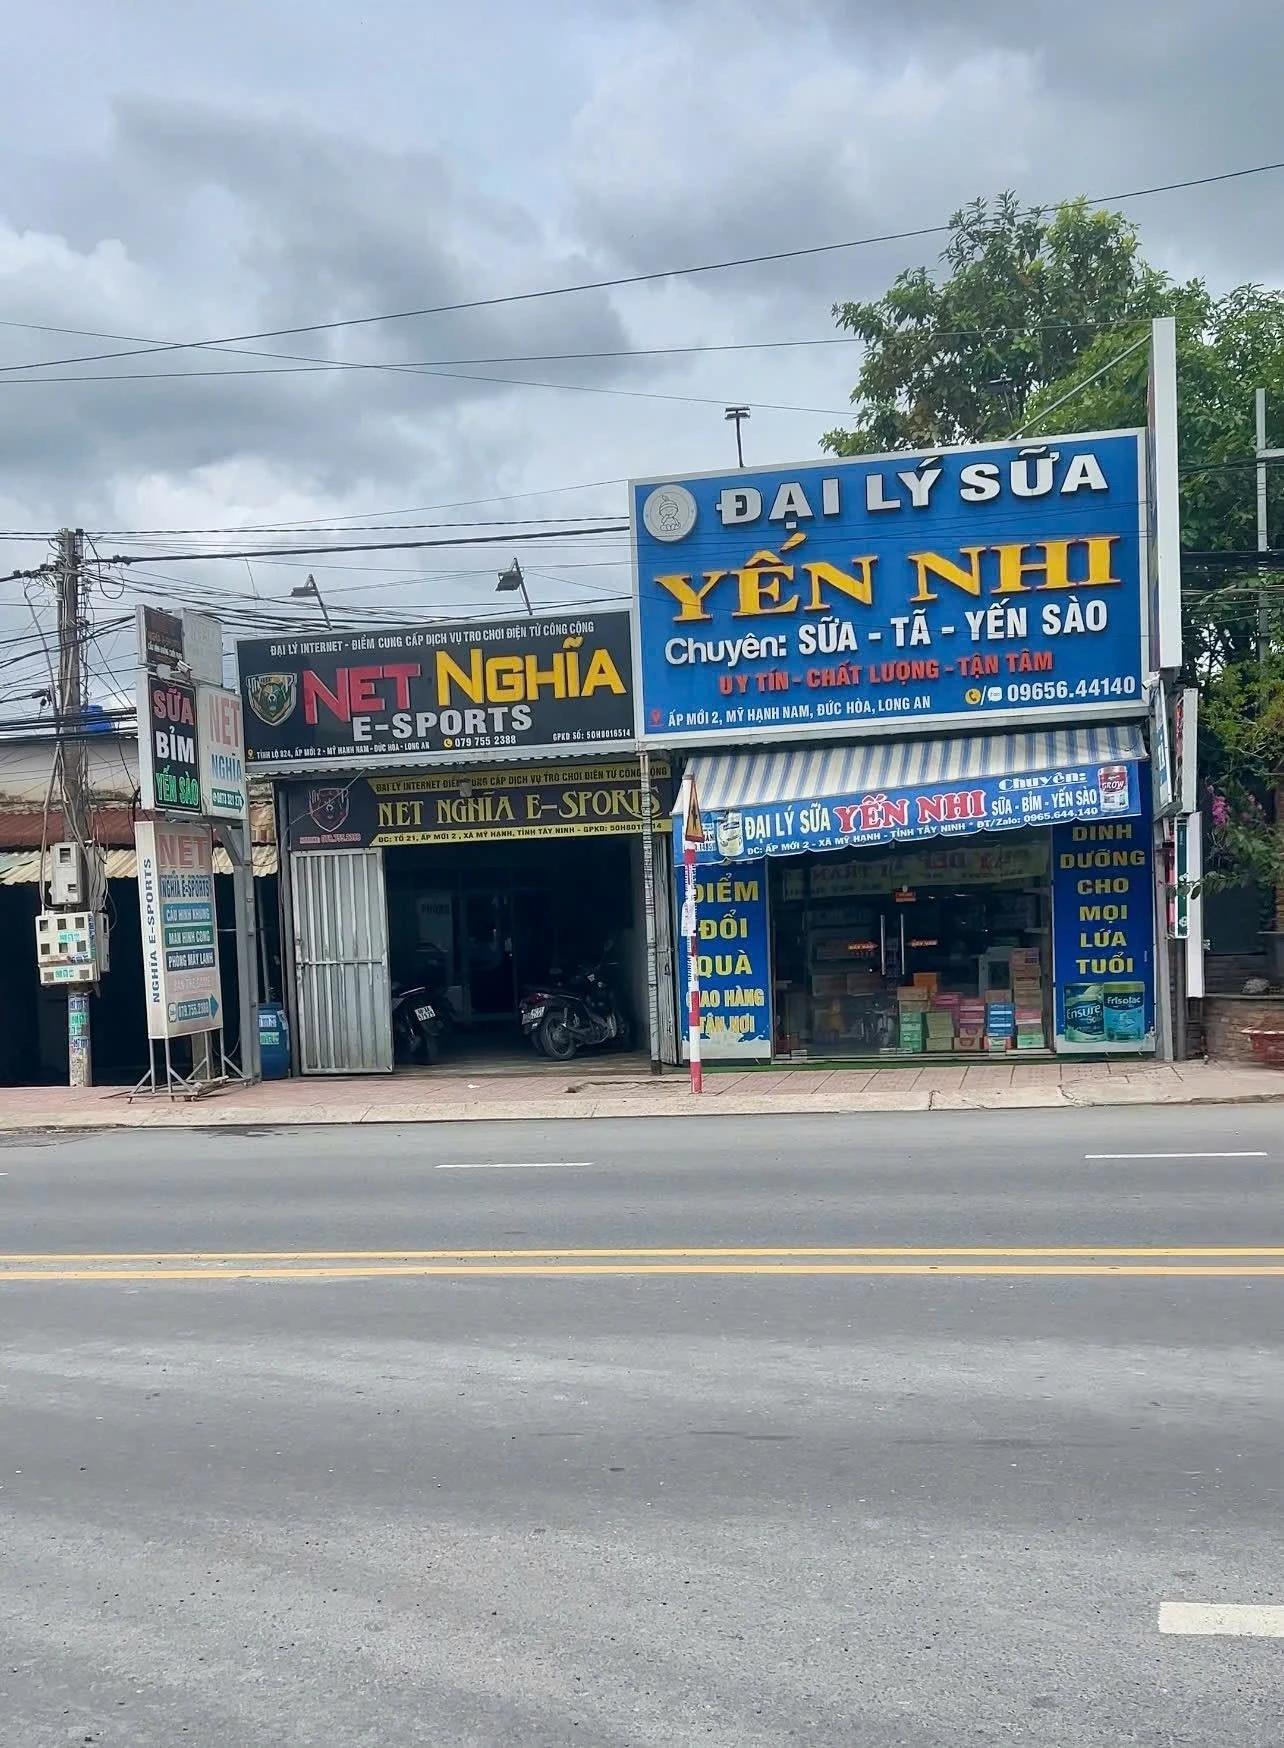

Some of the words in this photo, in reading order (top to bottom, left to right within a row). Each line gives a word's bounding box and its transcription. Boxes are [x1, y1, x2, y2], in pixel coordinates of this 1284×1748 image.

[715, 481, 840, 530] ĐẠI
[865, 456, 943, 513] LÝ
[959, 446, 1109, 502] SỮA
[654, 532, 880, 623] YẾN
[907, 535, 1121, 604] NHI
[288, 641, 298, 655] LÝ
[300, 640, 343, 655] INTERNET
[351, 634, 375, 651] ĐIỂM
[378, 636, 403, 649] CUNG
[405, 629, 424, 647] CẤP
[426, 632, 447, 647] DỊCH
[450, 631, 463, 645] VỤ
[506, 624, 527, 640] ĐIỆN
[529, 622, 542, 637] TỬ
[543, 621, 568, 637] CÔNG
[569, 620, 595, 636] CỘNG
[664, 632, 788, 667] Chuyên:
[798, 616, 859, 656] SỮA
[890, 607, 932, 648] TÃ
[964, 597, 1028, 641] YẾN
[1041, 595, 1108, 636] SÀO
[303, 663, 421, 725] NET
[435, 636, 627, 707] NGHĨA
[718, 674, 749, 696] UY
[756, 667, 789, 693] TÍN
[806, 658, 863, 689] CHẤT
[868, 659, 940, 686] LƯỢNG
[958, 653, 999, 680] TẬN
[1005, 648, 1054, 673] TÂM
[1007, 675, 1136, 702] 09656.44140
[153, 688, 195, 726] SỮA
[208, 694, 240, 748] NET
[352, 704, 533, 742] E-SPORTS
[667, 708, 684, 727] ẤP
[712, 710, 723, 726] 2,
[725, 704, 744, 722] MỸ
[747, 705, 781, 723] HẠNH
[783, 703, 814, 720] NAM,
[816, 697, 843, 715] ĐỨC
[847, 700, 875, 714] HÒA,
[878, 697, 910, 713] LONG
[913, 695, 931, 710] AN
[155, 726, 195, 765] BỈM
[454, 738, 473, 748] 079
[474, 737, 491, 747] 755
[493, 734, 517, 746] 2388
[178, 771, 199, 806] SÀO
[403, 780, 439, 791] INTERNET
[998, 771, 1087, 791] Chuyên:
[1102, 780, 1125, 791] GROW
[378, 801, 424, 826] NET
[436, 791, 516, 824] NGHĨA
[527, 785, 664, 820] E-SPORTS
[745, 814, 771, 843] ĐẠI
[775, 805, 794, 836] LÝ
[799, 803, 831, 834] SỮA
[833, 793, 908, 834] YẾN
[916, 789, 987, 824] NHI
[1021, 791, 1042, 813] BỈM
[1051, 786, 1074, 809] YẾN
[1075, 786, 1098, 806] SÀO
[765, 841, 779, 853] ẤP
[781, 842, 800, 851] MỚI
[802, 841, 810, 850] 2
[818, 837, 832, 847] XÃ
[835, 837, 850, 845] MỸ
[853, 833, 881, 845] HẠNH
[917, 825, 937, 836] TÂY
[940, 823, 966, 833] NINH
[1023, 806, 1099, 823] 0965.644.140
[1073, 824, 1132, 842] DINH
[158, 833, 209, 868] NET
[1060, 848, 1145, 869] DƯỠNG
[143, 857, 157, 945] E-SPORTS
[1077, 877, 1129, 895] CHO
[698, 909, 748, 940] ĐỔI
[1079, 904, 1128, 924] MỌI
[1080, 928, 1127, 948] LỨA
[696, 950, 752, 978] QUÀ
[1076, 951, 1134, 975] TUỔI
[724, 985, 765, 1007] HÀNG
[1067, 1004, 1101, 1020] Ensure
[1107, 996, 1141, 1005] Frisolac
